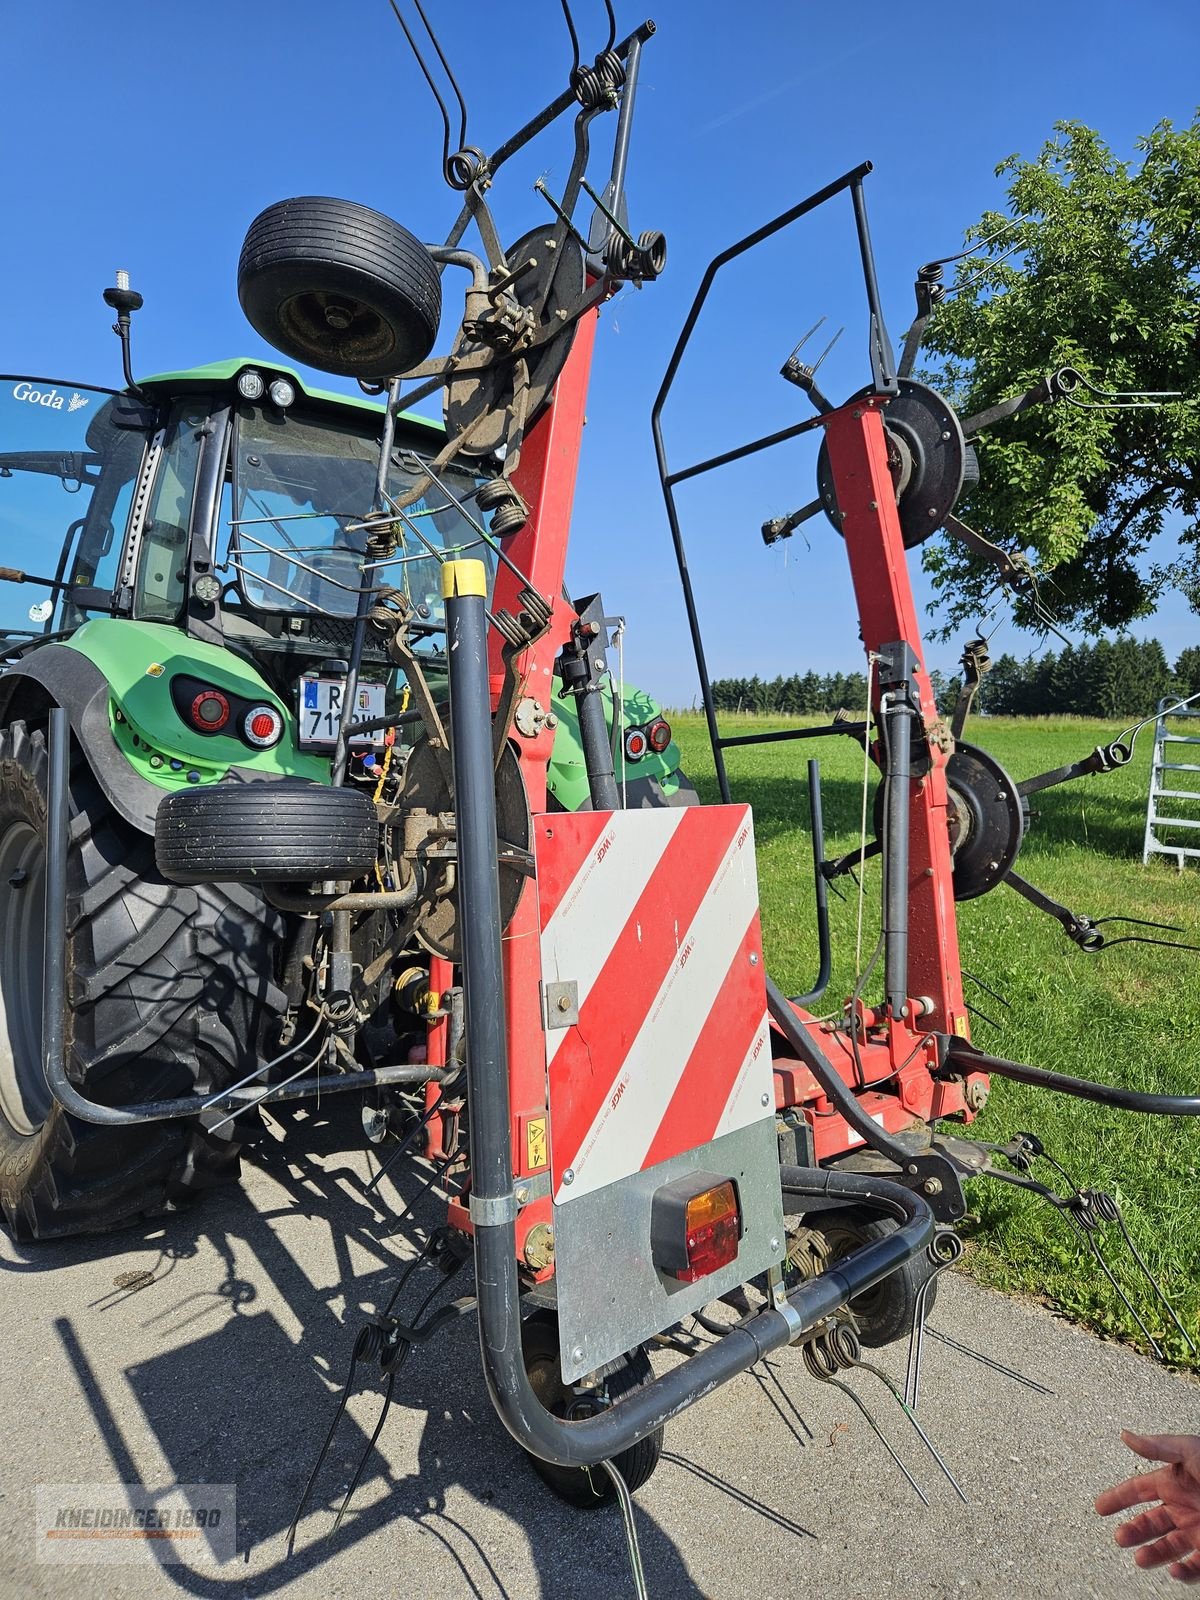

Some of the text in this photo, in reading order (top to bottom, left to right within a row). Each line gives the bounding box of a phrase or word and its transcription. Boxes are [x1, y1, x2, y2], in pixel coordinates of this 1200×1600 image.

[13, 382, 64, 410] Goda
[307, 699, 314, 707] A
[597, 838, 611, 864] WGF
[737, 828, 749, 850] WGF
[680, 945, 692, 969] WGF
[752, 1038, 764, 1061] WGF
[611, 1082, 626, 1110] WGF
